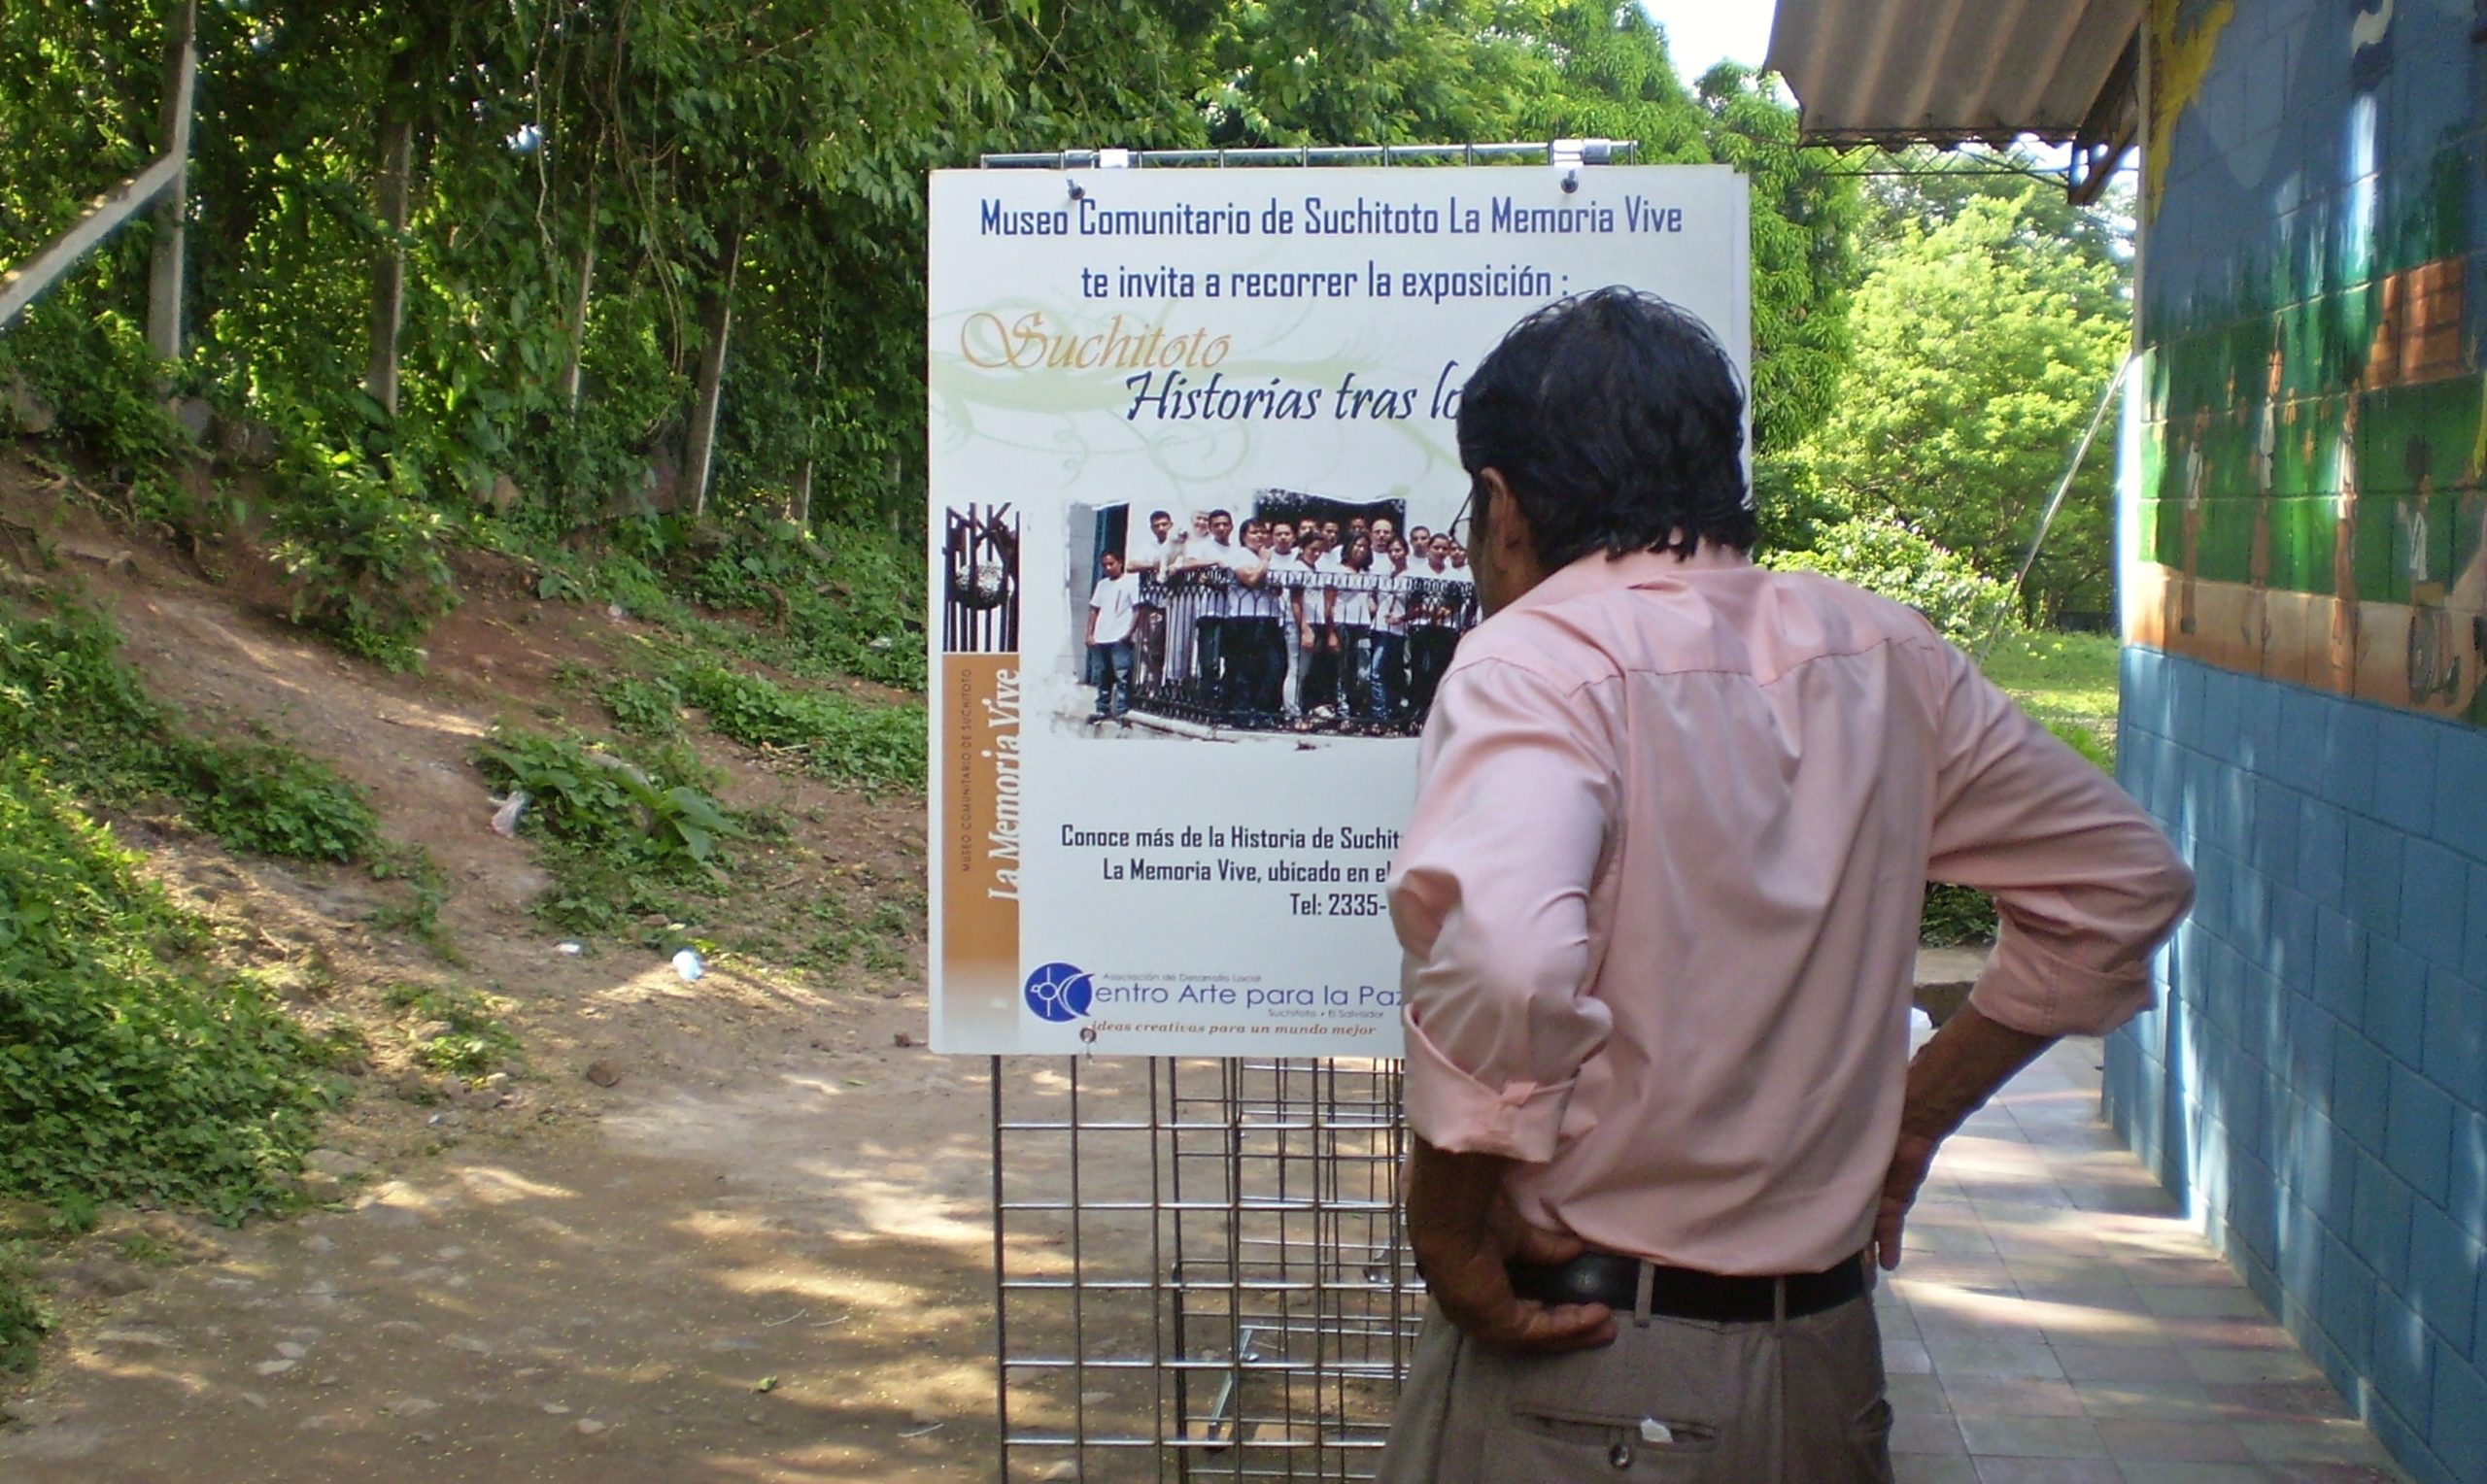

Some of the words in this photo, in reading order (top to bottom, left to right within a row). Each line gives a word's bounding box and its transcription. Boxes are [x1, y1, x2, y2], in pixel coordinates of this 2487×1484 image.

[981, 198, 1069, 236] Museo
[1079, 198, 1250, 236] Comunitario
[1261, 197, 1294, 235] de
[1305, 196, 1439, 235] Suchitoto
[1449, 196, 1481, 234] La
[1491, 196, 1614, 234] Memoria
[1624, 194, 1683, 233] Vive
[1080, 267, 1108, 298] te
[1119, 265, 1195, 298] invita
[1205, 273, 1220, 298] a
[1231, 272, 1358, 298] recorrer
[1368, 259, 1391, 297] la
[1402, 265, 1551, 305] exposición
[960, 311, 1232, 369] Suchitoto
[1125, 370, 1322, 421] Historias
[1335, 372, 1418, 421] tras
[961, 668, 971, 731] SUCHITOTO
[961, 734, 971, 749] DE
[961, 752, 971, 830] COMUNITARIO
[961, 835, 971, 872] MUSEO
[1061, 824, 1130, 848] Conoce
[1136, 827, 1175, 848] más
[1180, 825, 1203, 848] de
[1209, 825, 1225, 848] la
[1231, 825, 1306, 849] Historia
[1312, 826, 1334, 850] de
[1341, 826, 1404, 849] Suchit
[1103, 857, 1124, 881] La
[1130, 858, 1211, 881] Memoria
[1217, 858, 1262, 884] Vive,
[1268, 859, 1341, 883] ubicado
[1346, 866, 1369, 883] en
[1103, 973, 1161, 983] Asociación
[1178, 984, 1237, 1004] Arte
[1246, 988, 1315, 1009] para
[1324, 984, 1348, 1006] la
[1091, 1021, 1131, 1032] ideas
[1135, 1022, 1205, 1033] creativas
[1209, 1025, 1246, 1036] para
[1250, 1026, 1271, 1035] un
[1275, 1023, 1328, 1035] mundo
[1332, 1025, 1377, 1038] mejor
